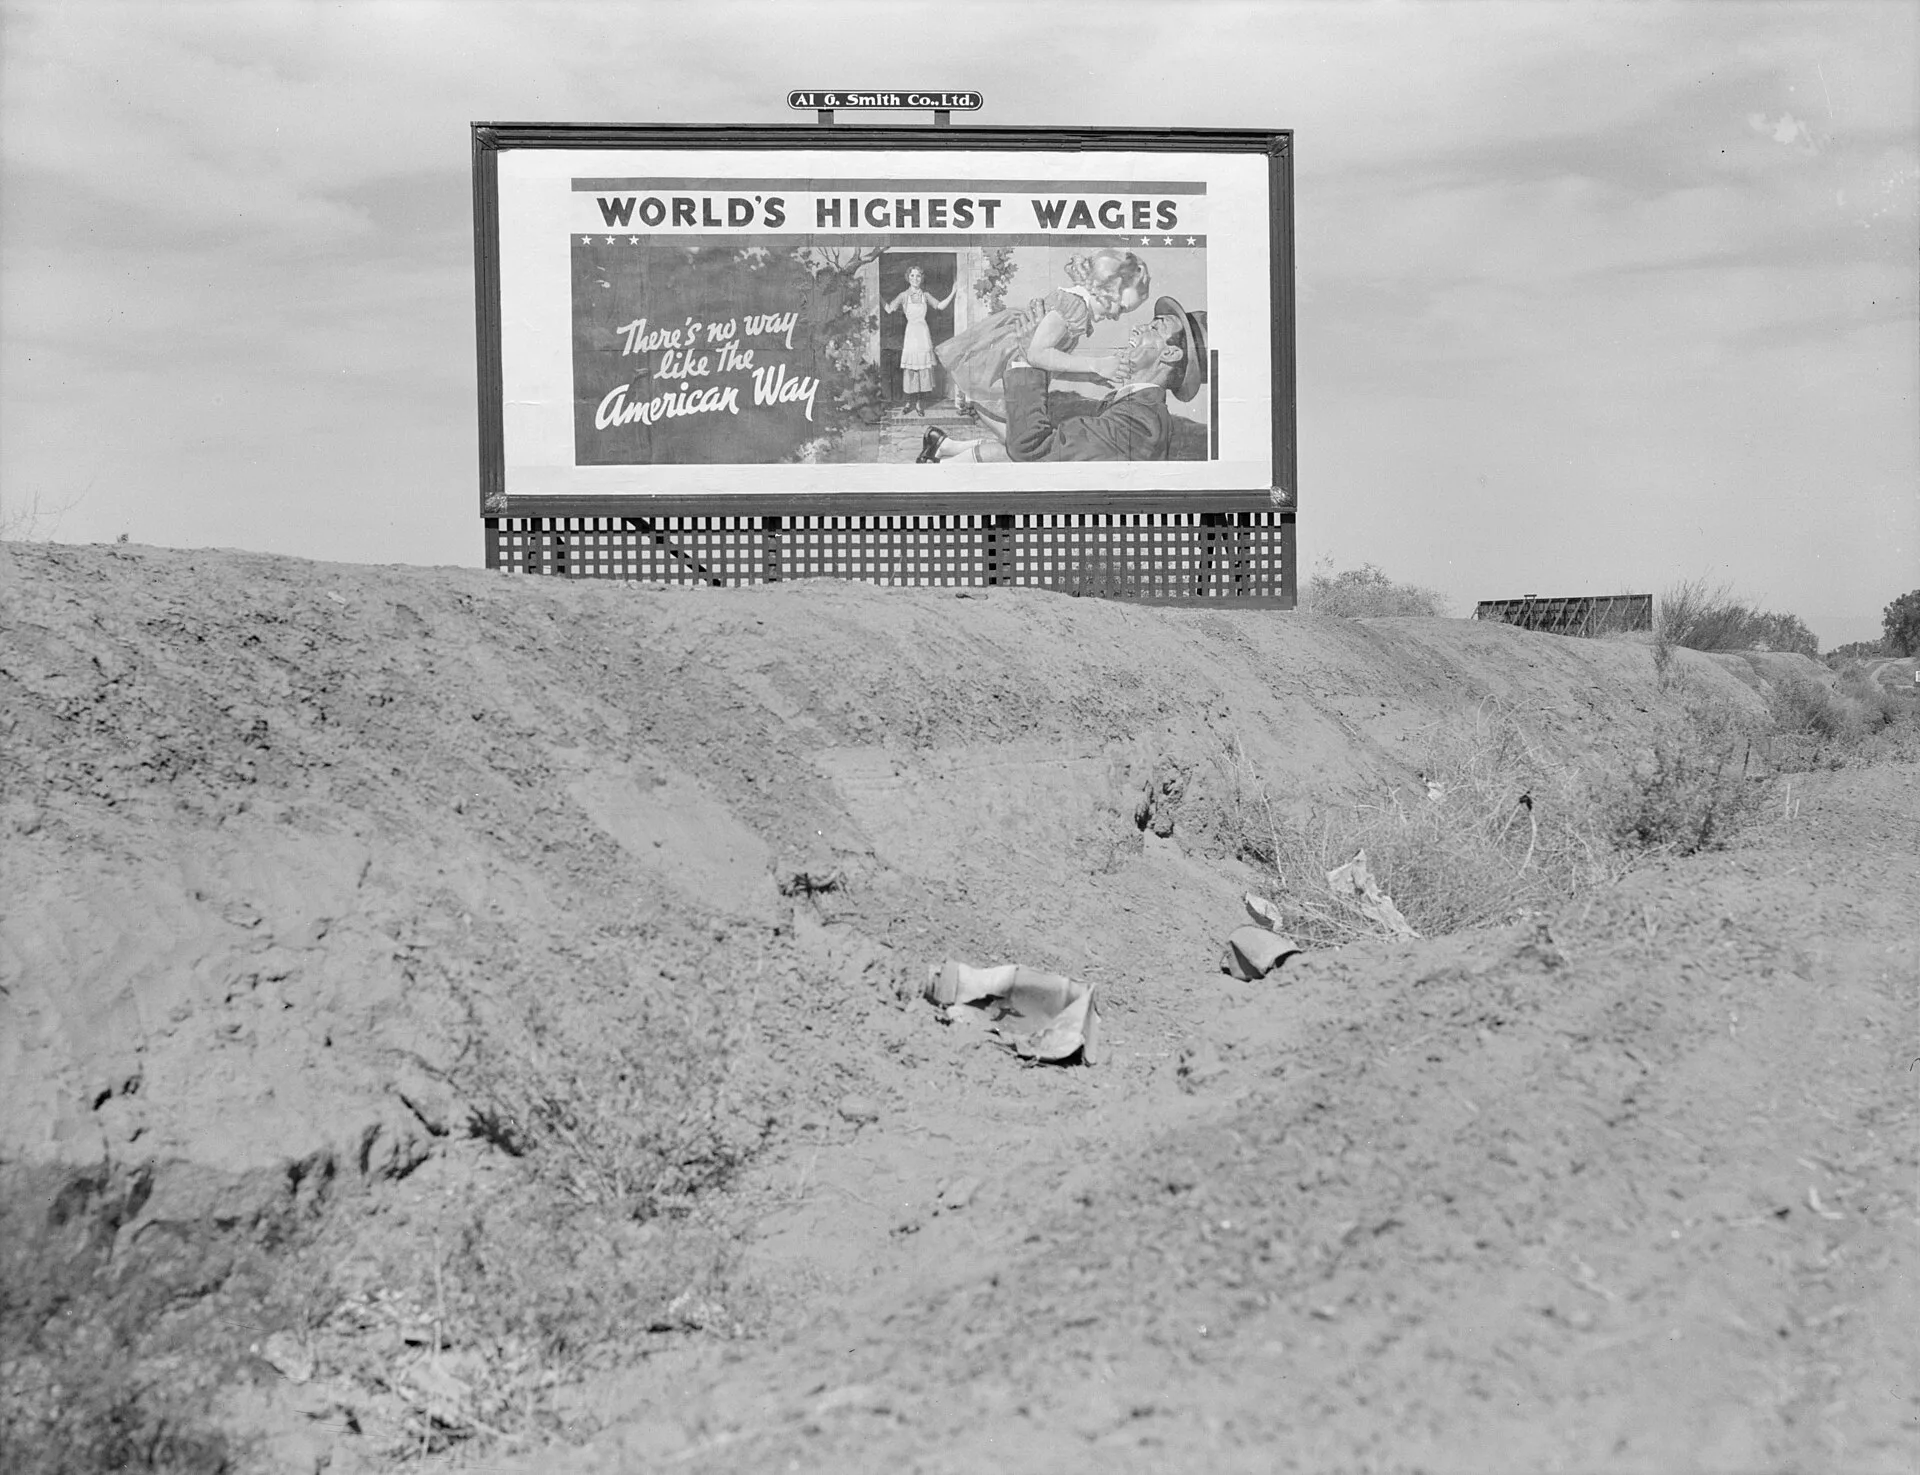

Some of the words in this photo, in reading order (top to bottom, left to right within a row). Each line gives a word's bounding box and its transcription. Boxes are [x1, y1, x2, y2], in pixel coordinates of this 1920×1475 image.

[795, 94, 815, 106] Al
[845, 94, 901, 106] Smith
[597, 196, 785, 228] WORLD'S
[816, 197, 1002, 229] HIGHEST
[1031, 199, 1178, 231] WAGES
[617, 318, 702, 356] There's
[707, 318, 737, 343] no
[743, 312, 798, 350] way
[653, 351, 710, 380] like
[595, 382, 739, 430] American
[751, 363, 819, 422] Way
